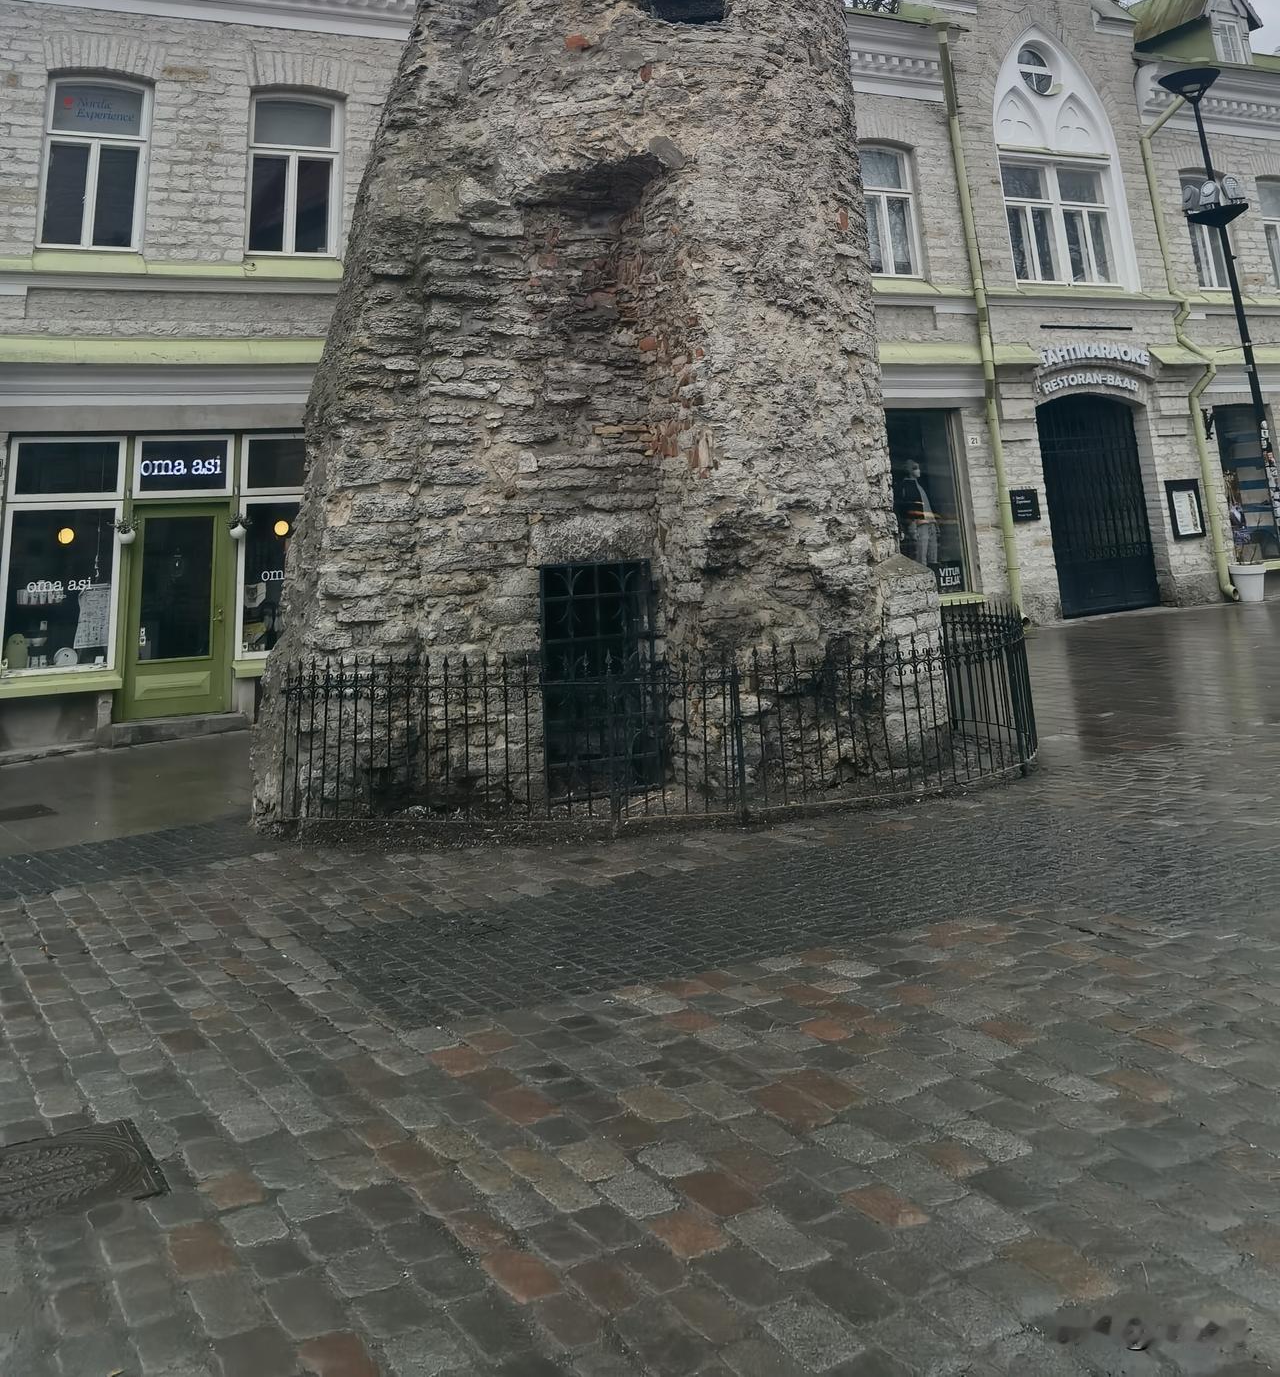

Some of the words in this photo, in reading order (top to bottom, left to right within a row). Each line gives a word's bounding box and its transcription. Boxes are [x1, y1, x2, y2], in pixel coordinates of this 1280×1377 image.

[1042, 372, 1139, 395] RESTORAN-BAAR
[140, 459, 187, 476] oma
[191, 455, 222, 475] asi
[26, 580, 64, 593] oma
[67, 576, 93, 591] asi
[261, 570, 285, 582] om
